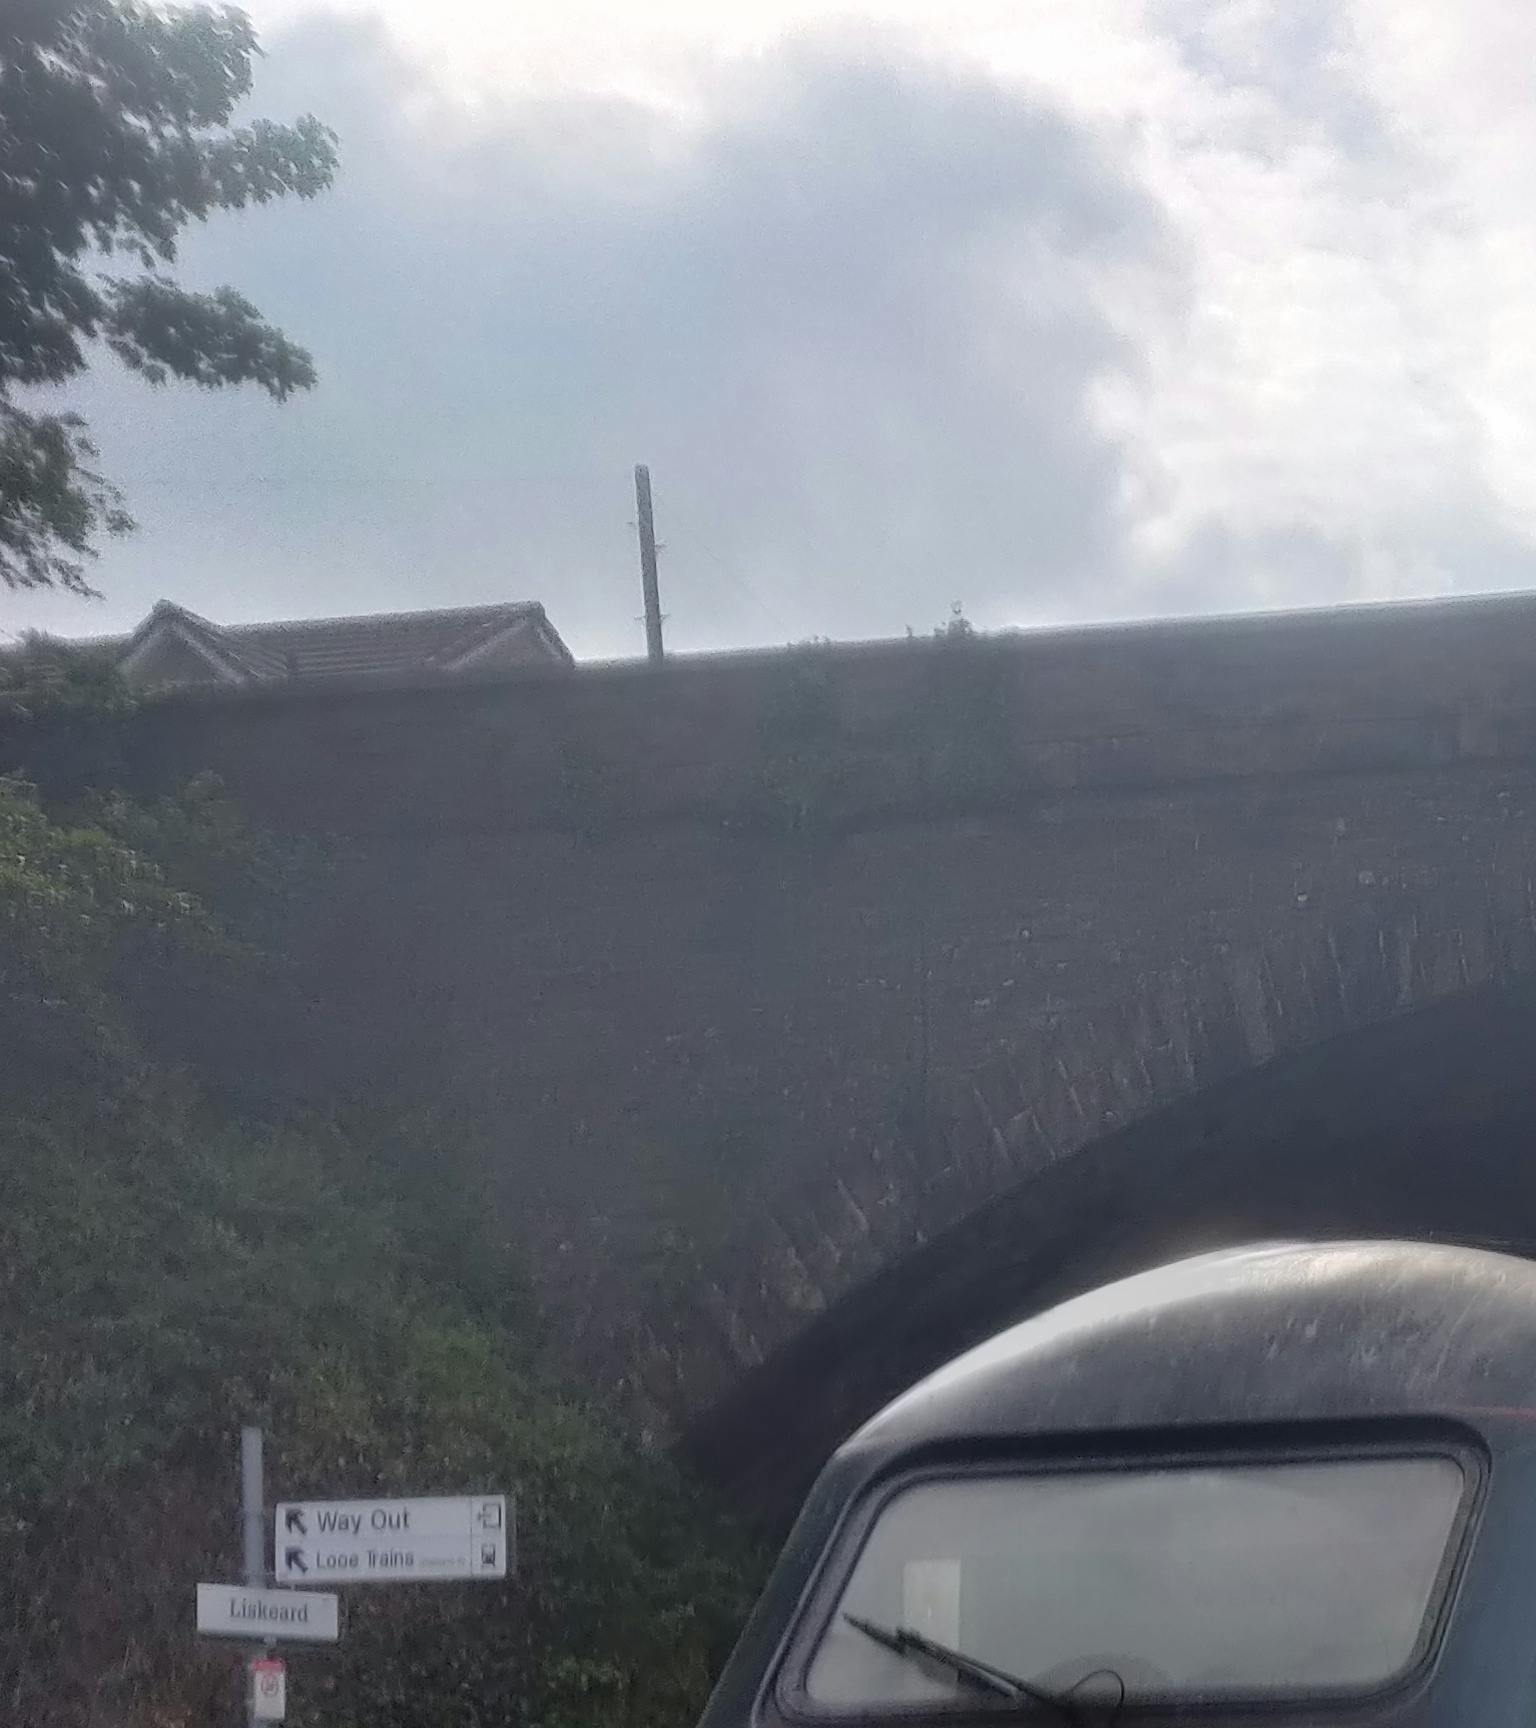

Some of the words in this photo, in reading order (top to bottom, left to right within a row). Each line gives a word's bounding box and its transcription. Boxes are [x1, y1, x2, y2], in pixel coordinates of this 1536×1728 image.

[316, 1510, 361, 1536] Way
[371, 1507, 410, 1529] Out
[316, 1551, 359, 1568] Looe
[367, 1547, 414, 1568] Trains
[230, 1599, 308, 1623] Liskeard
